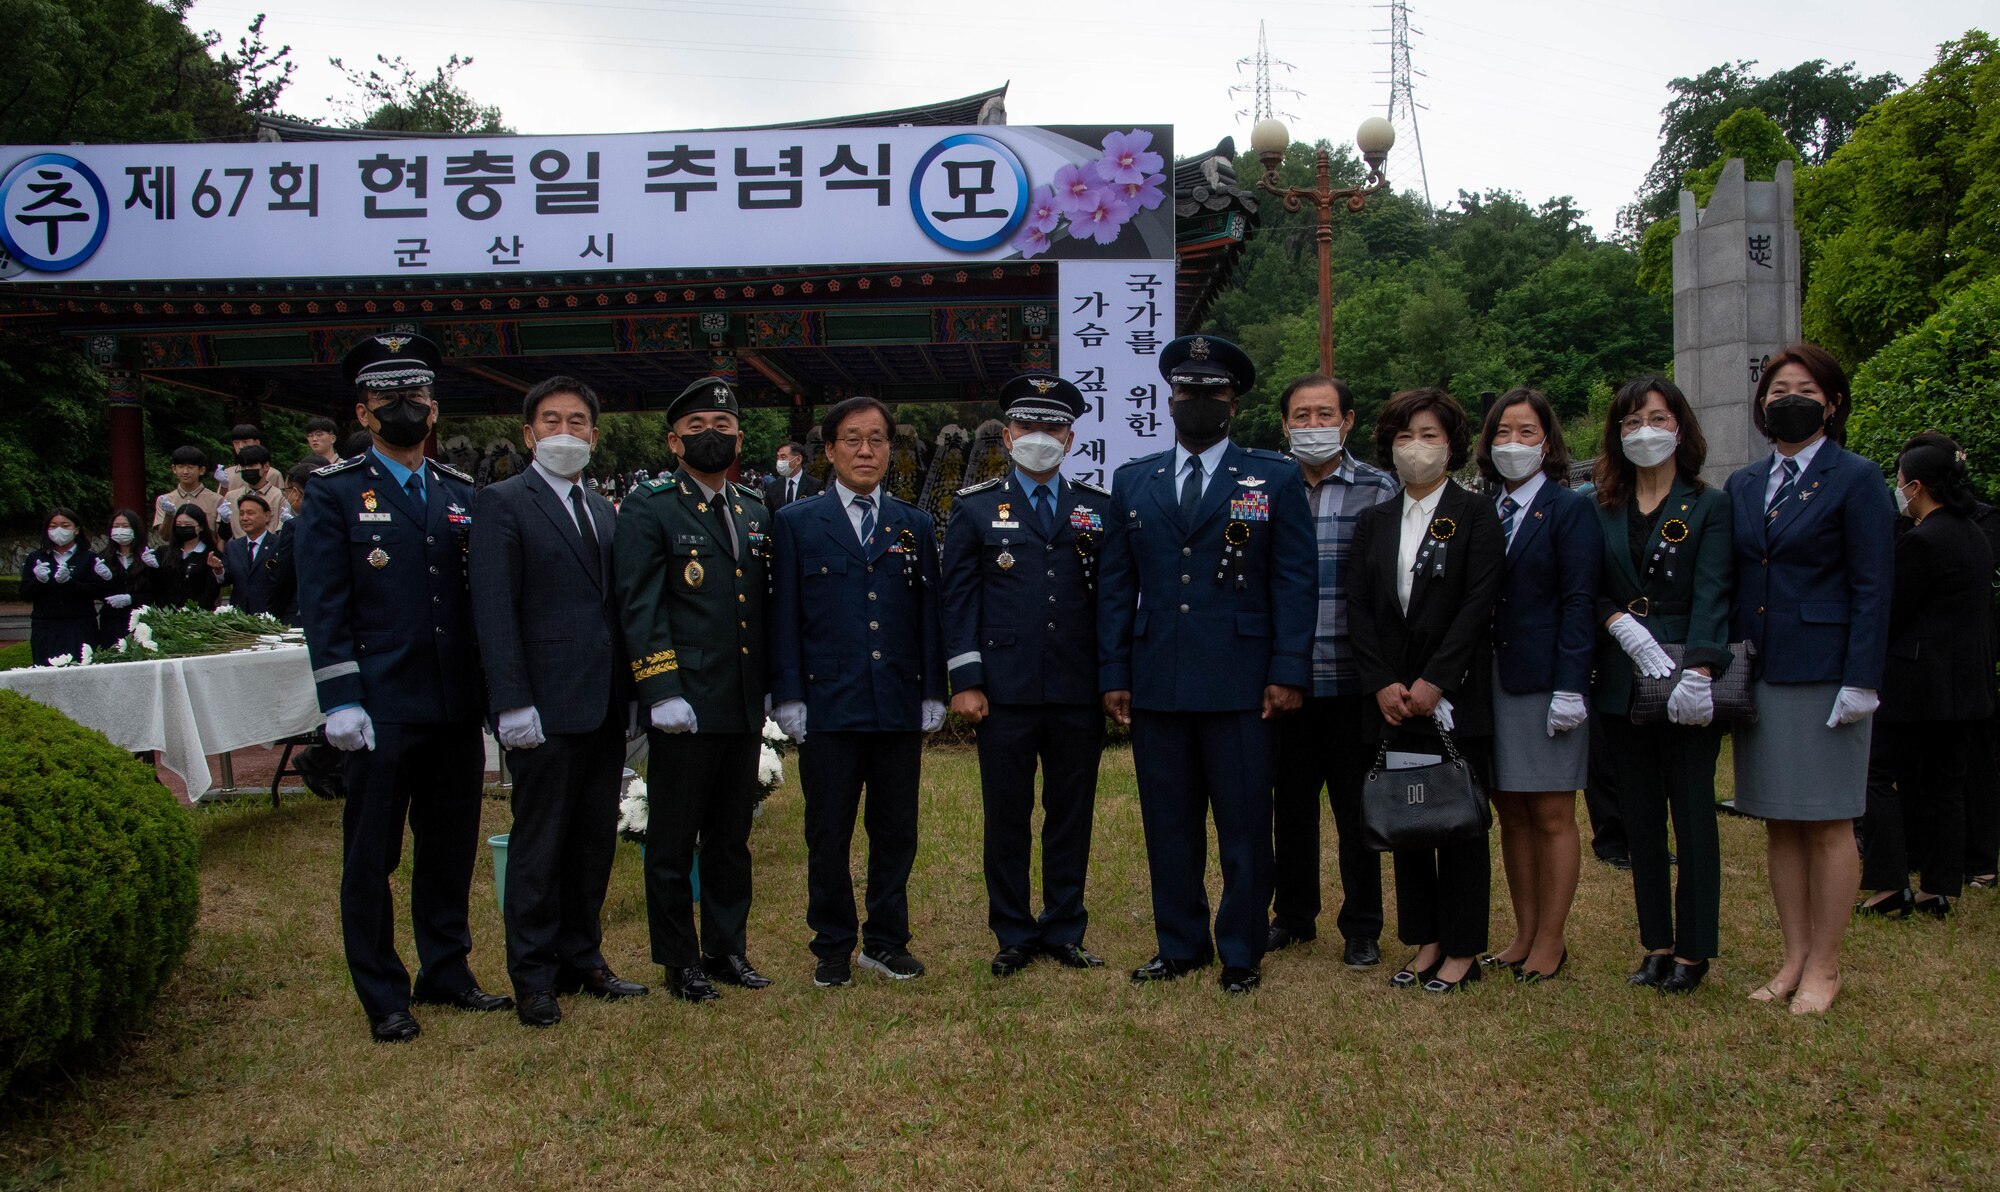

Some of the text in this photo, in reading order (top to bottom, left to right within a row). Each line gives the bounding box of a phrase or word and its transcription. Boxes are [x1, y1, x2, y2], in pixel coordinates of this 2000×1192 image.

[15, 170, 91, 256] 추
[125, 143, 891, 221] 제67회 현충일 추념식
[931, 159, 1009, 222] 모
[1071, 291, 1110, 347] 가슴
[1124, 273, 1164, 437] 국가를 위한
[1072, 366, 1108, 423] 깊이
